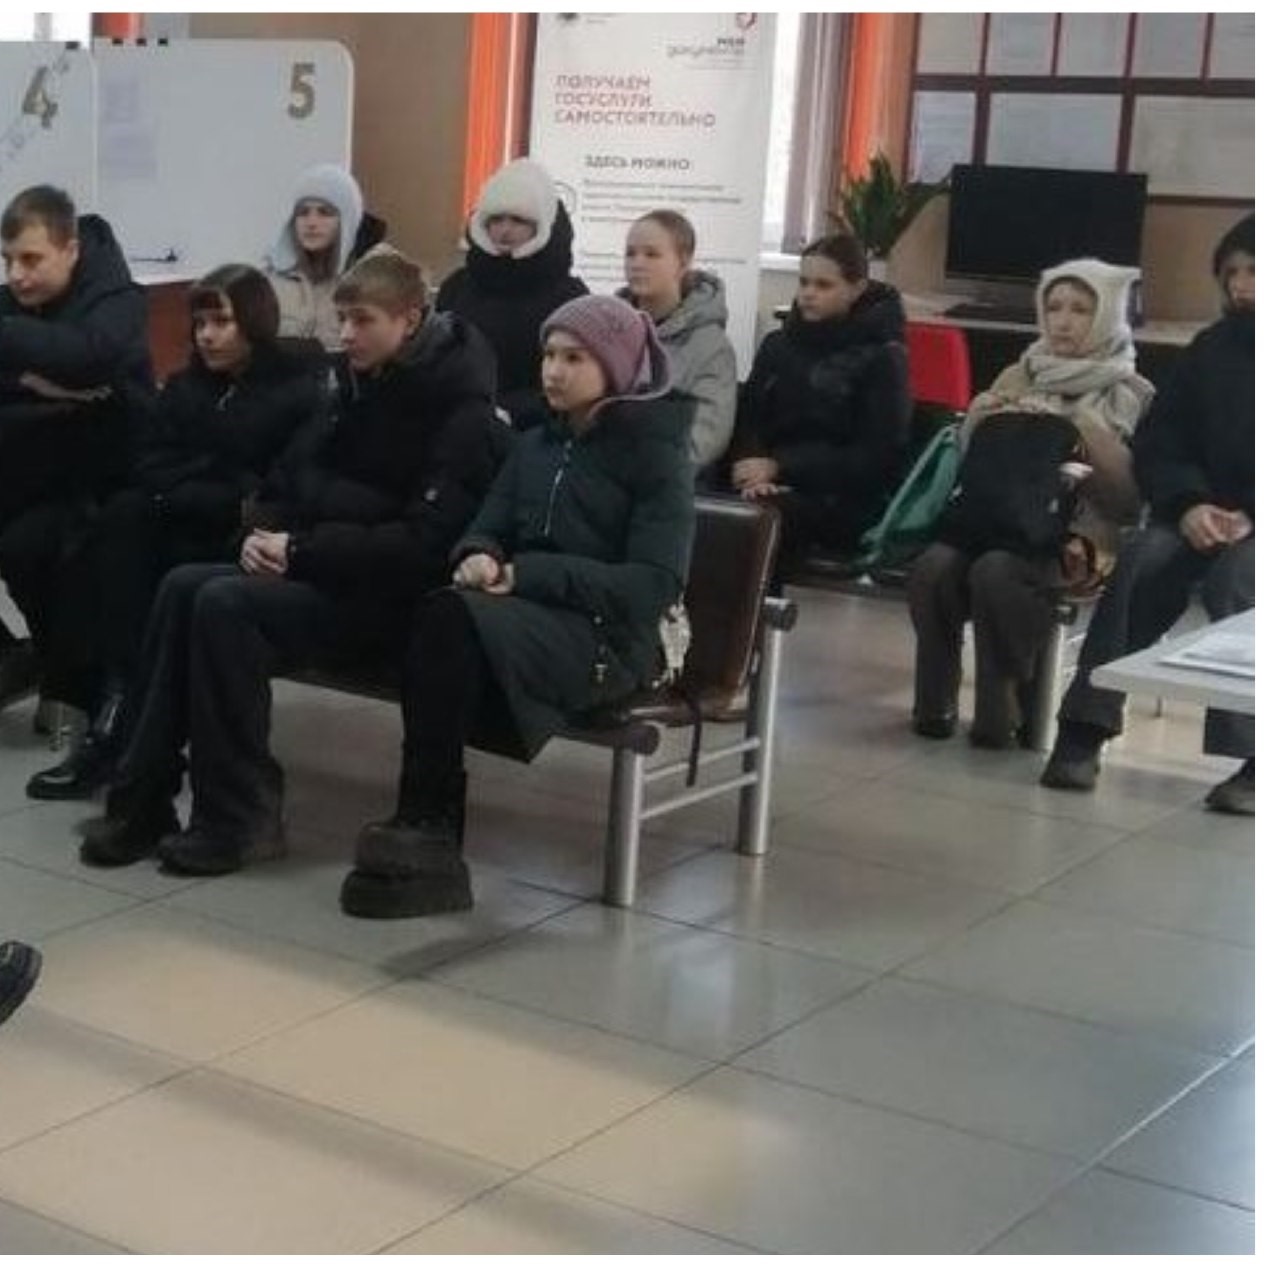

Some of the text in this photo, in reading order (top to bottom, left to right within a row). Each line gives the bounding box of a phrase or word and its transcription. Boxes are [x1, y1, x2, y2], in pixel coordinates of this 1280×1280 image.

[556, 74, 651, 90] ПОЛУЧАЕМ
[22, 66, 58, 128] 4
[287, 62, 315, 120] 5
[554, 92, 652, 108] ГОСУСЛУГИ
[554, 109, 717, 127] САМОСТОЯТЕЛЬНО
[585, 154, 627, 169] ЗДЕСЬ
